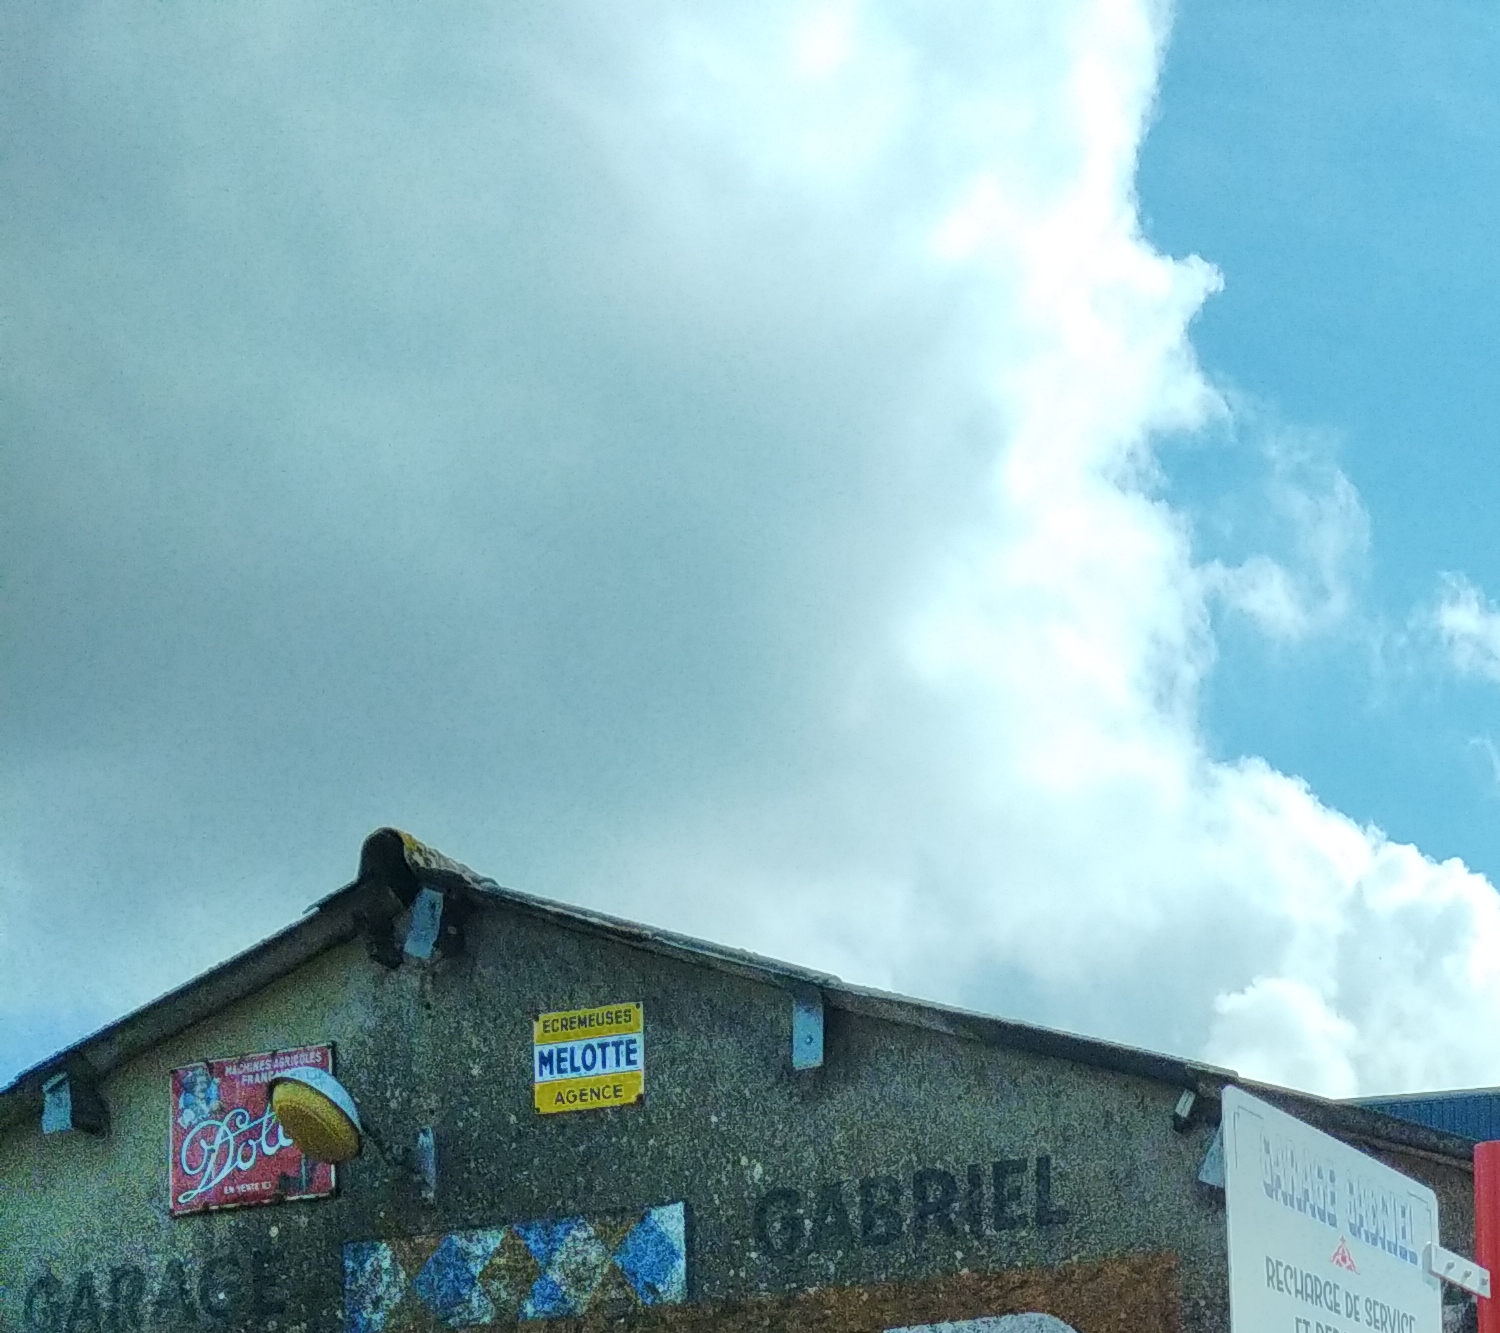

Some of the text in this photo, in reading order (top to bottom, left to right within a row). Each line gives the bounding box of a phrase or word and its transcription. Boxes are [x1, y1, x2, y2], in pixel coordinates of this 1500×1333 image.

[542, 1008, 632, 1033] ECREMEUSES
[537, 1038, 638, 1078] MELOTTE
[554, 1084, 624, 1106] AGENCE
[754, 1156, 1072, 1260] GABRIEL
[1265, 1256, 1340, 1315] RECHARGE
[1345, 1290, 1360, 1322] DE
